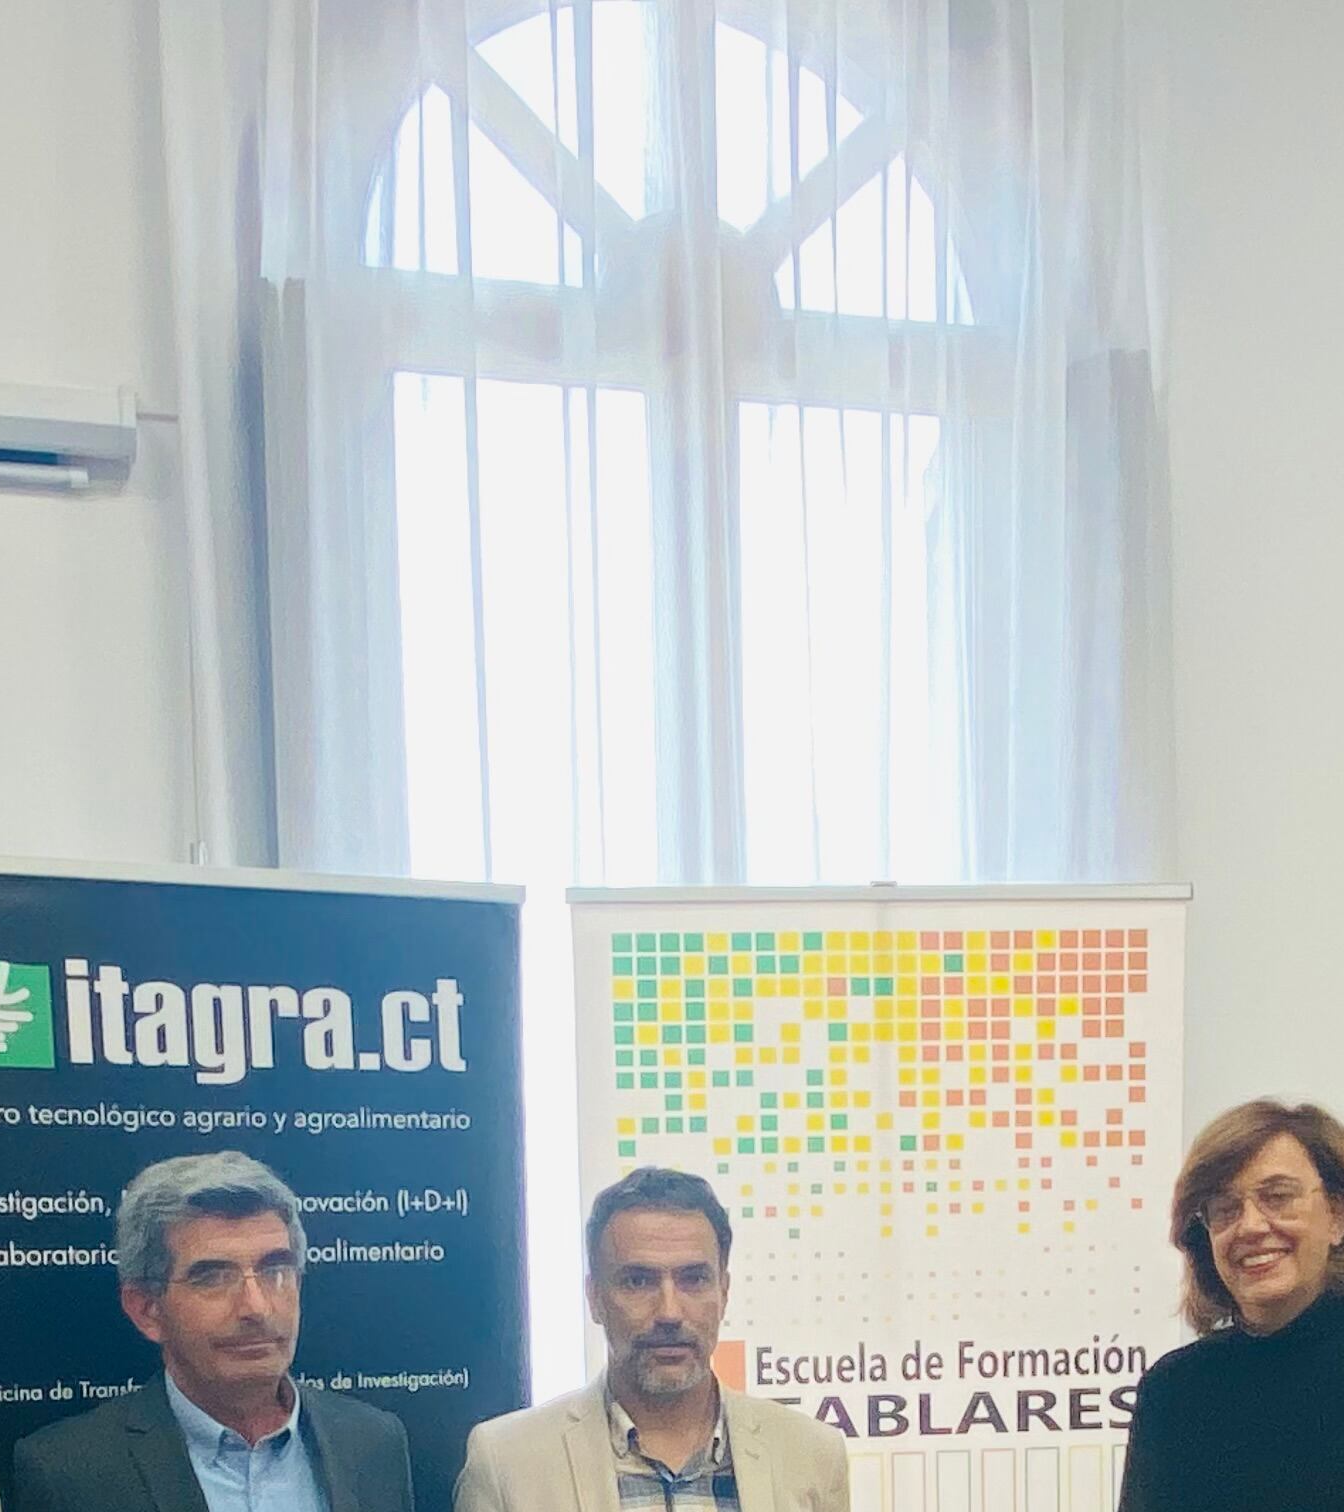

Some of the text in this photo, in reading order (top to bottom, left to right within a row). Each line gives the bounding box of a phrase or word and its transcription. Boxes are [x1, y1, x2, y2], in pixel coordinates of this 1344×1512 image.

[64, 957, 467, 1085] itagra.ct
[28, 1102, 176, 1133] tecnológico
[183, 1104, 267, 1132] agrario
[273, 1110, 287, 1133] y
[294, 1104, 472, 1132] agroalimentario
[397, 1188, 469, 1218] (I+D+I)
[755, 1333, 1148, 1386] Escuela de Formación
[49, 1379, 74, 1400] de
[330, 1370, 353, 1390] de
[358, 1366, 469, 1393] Investigación)
[768, 1385, 1137, 1438] ABLARES
